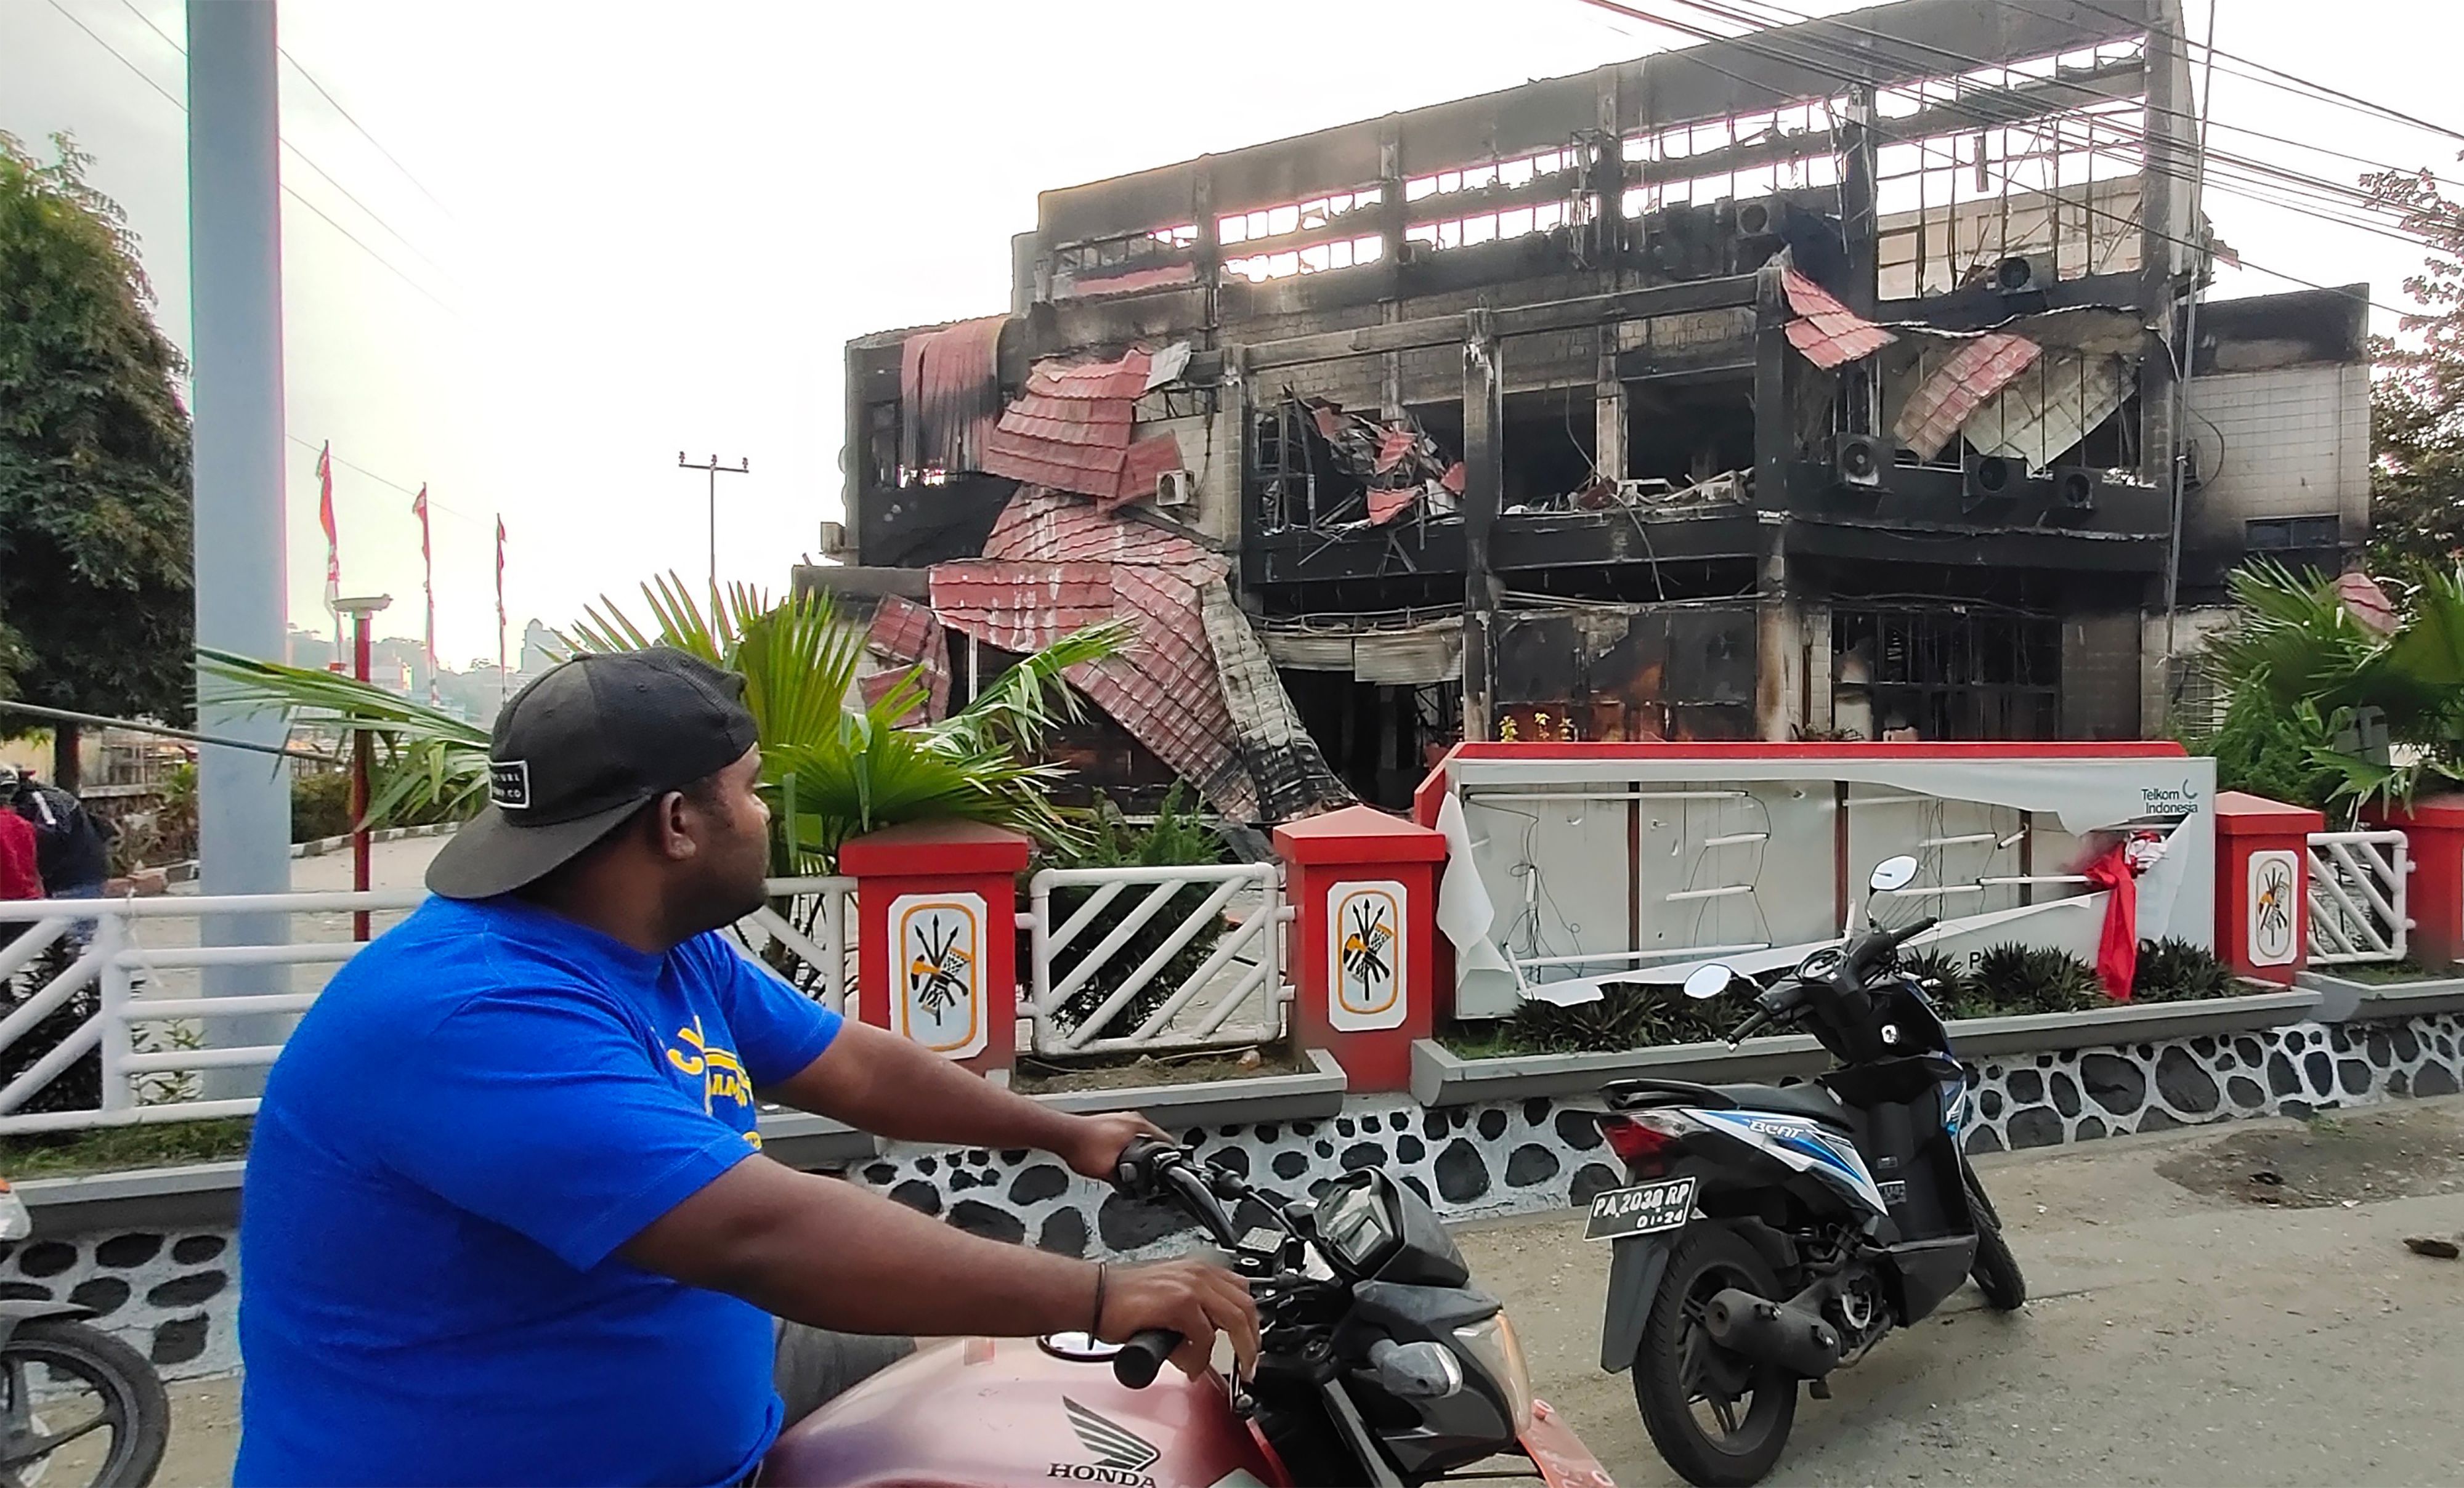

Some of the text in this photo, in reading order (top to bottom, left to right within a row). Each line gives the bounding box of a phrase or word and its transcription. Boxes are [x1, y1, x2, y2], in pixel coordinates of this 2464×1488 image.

[2141, 788, 2179, 800] Telkom
[2146, 801, 2198, 813] Indonesia
[1593, 1196, 1617, 1217] PA
[1664, 1184, 1689, 1205] RP
[1047, 1463, 1156, 1488] HONDA
